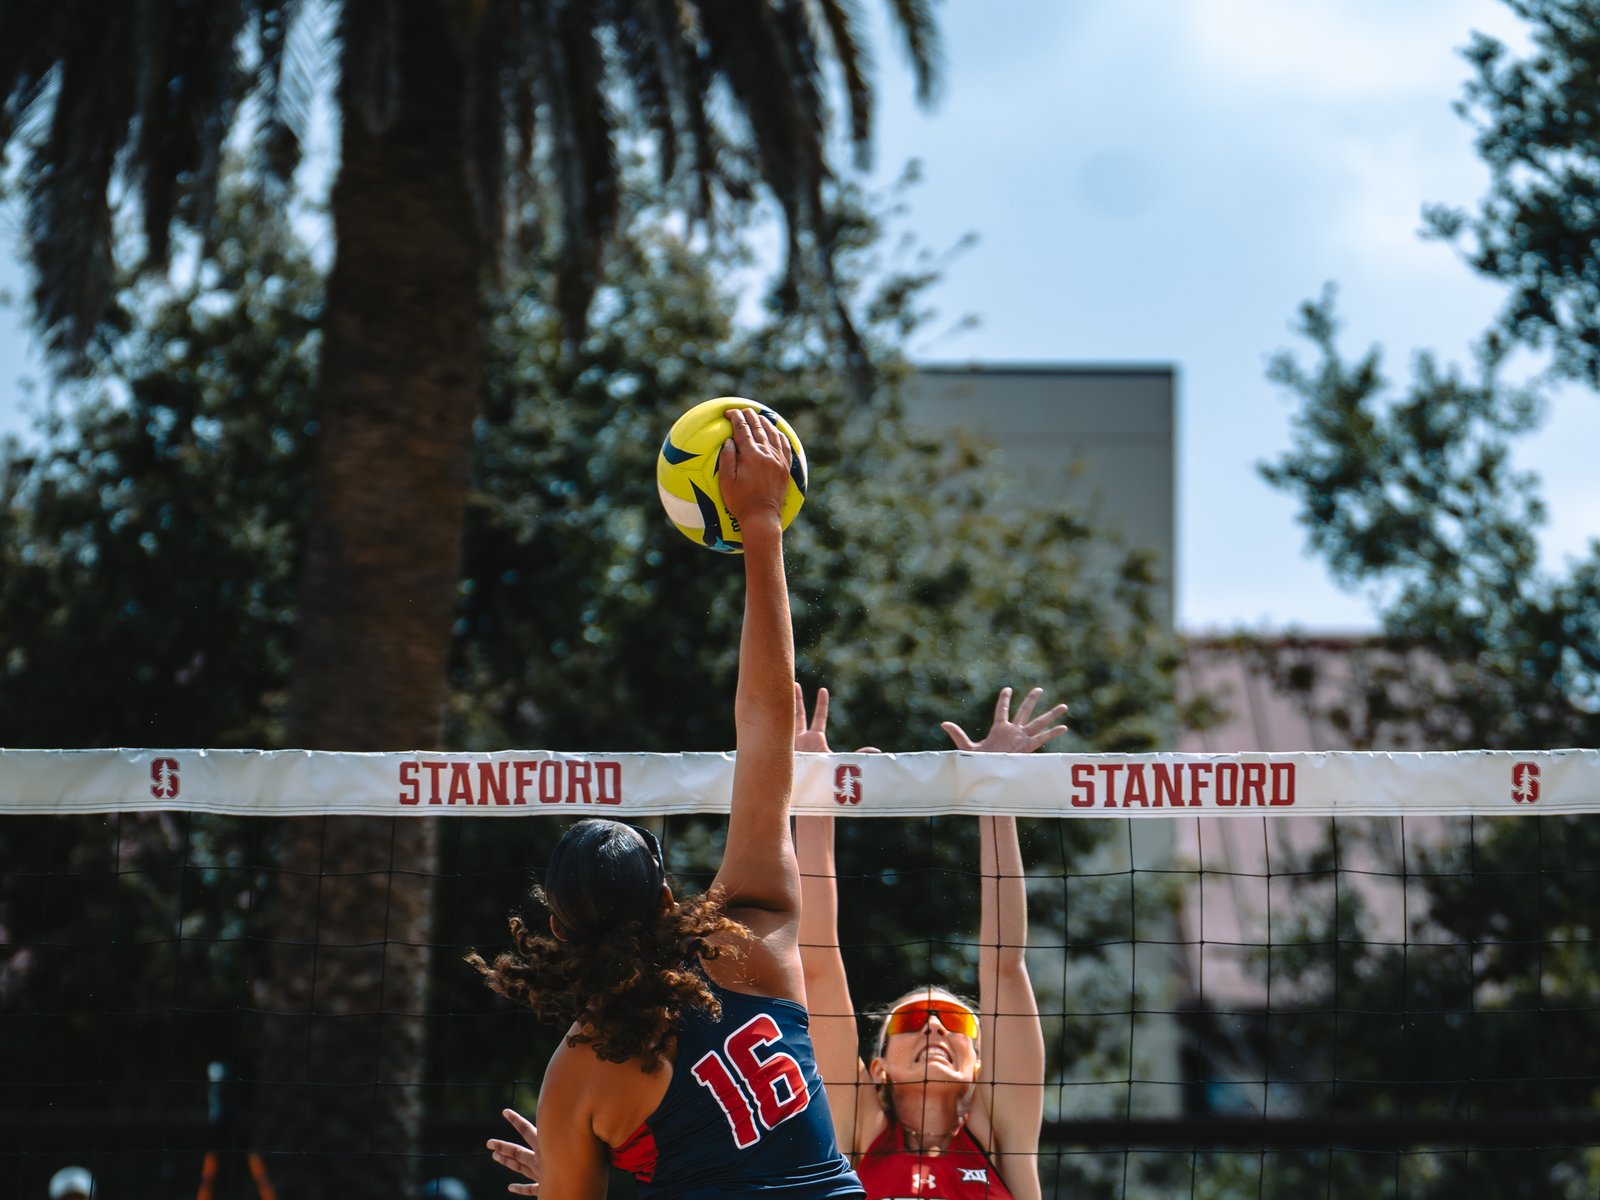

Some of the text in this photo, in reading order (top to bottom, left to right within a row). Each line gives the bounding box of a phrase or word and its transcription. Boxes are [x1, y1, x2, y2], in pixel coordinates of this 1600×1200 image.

[399, 760, 622, 806] STANFORD
[1071, 762, 1296, 807] STANFORD
[691, 1013, 811, 1150] 16
